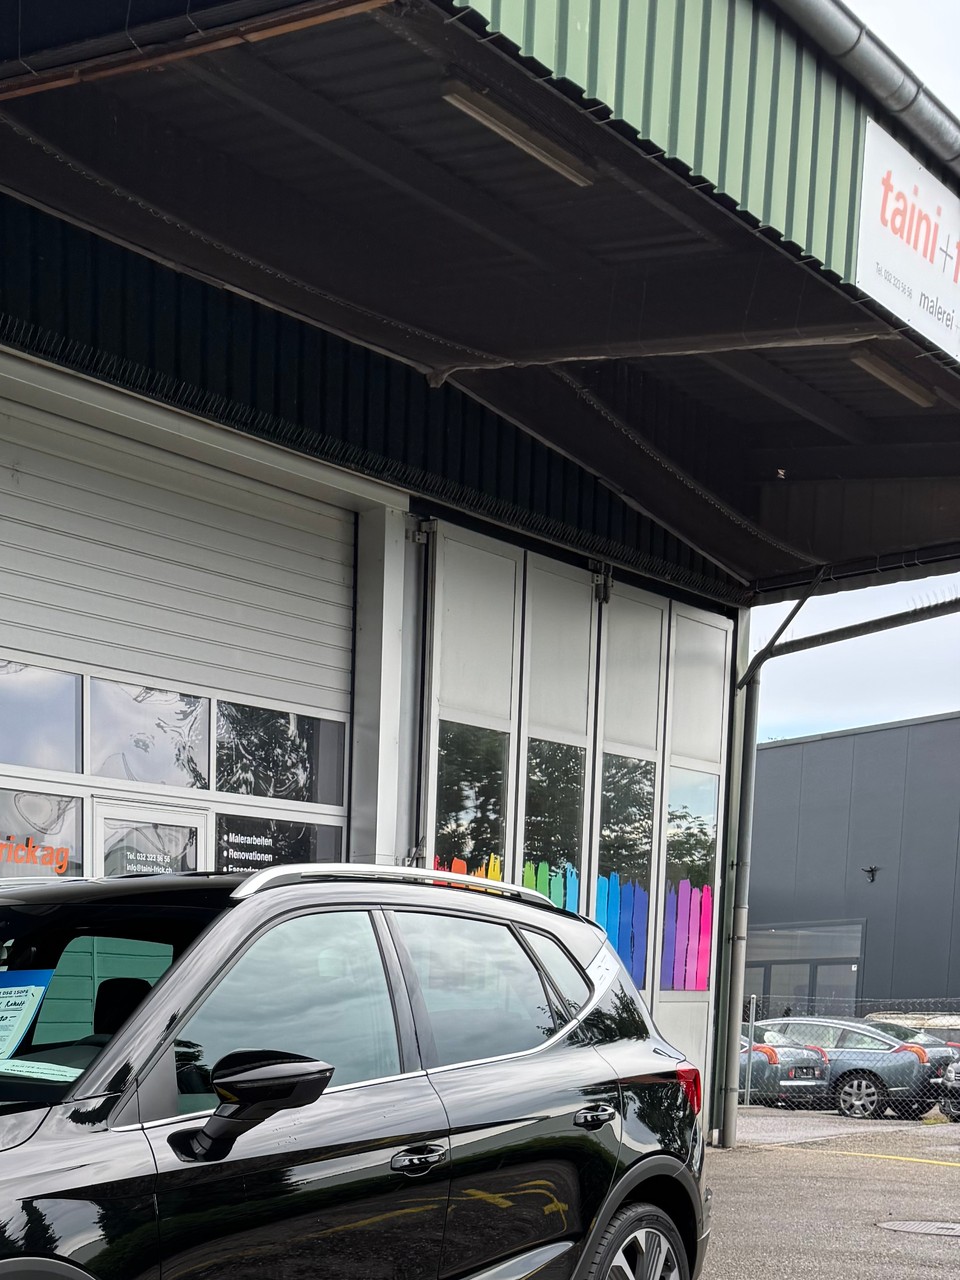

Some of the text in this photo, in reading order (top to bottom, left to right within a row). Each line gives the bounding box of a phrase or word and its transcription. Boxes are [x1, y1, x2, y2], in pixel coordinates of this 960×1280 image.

[919, 291, 955, 330] malerei
[229, 832, 273, 847] Malerarbeiten
[41, 845, 69, 874] ag
[228, 848, 273, 862] Renovationen
